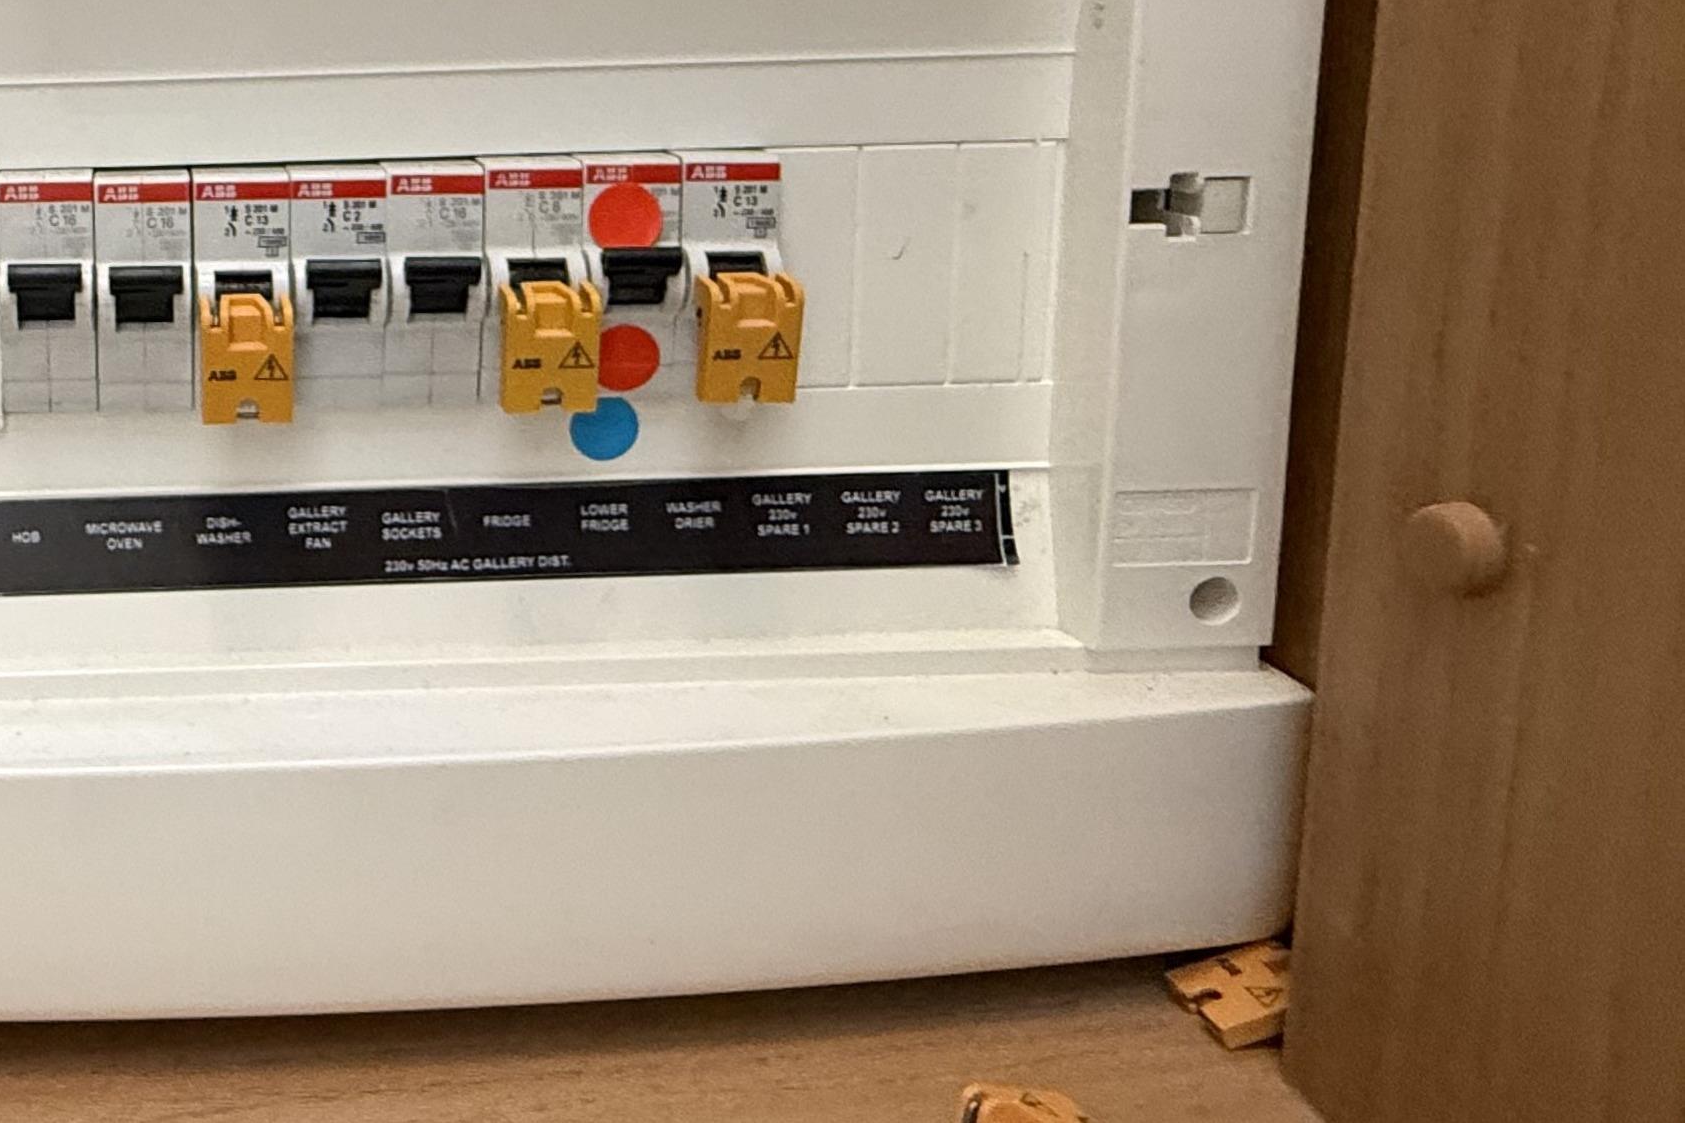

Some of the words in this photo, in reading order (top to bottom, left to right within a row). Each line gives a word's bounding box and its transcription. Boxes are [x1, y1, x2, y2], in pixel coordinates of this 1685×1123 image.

[690, 165, 727, 179] ABB
[495, 173, 530, 187] ABB
[4, 186, 39, 200] ABB
[103, 187, 138, 201] ABB
[202, 185, 236, 198] ABB
[714, 349, 741, 360] ABB
[512, 359, 541, 369] ABB
[208, 370, 237, 381] ABB
[752, 493, 812, 506] GALLERY
[841, 491, 900, 503] GALLERY
[925, 489, 984, 501] GALLERY
[288, 506, 346, 519] GALLERY
[581, 504, 628, 516] LOWER
[666, 501, 722, 513] WASHER
[382, 512, 440, 524] GALLERY
[483, 515, 530, 527] FRIDGE
[675, 517, 714, 529] DRIER
[85, 521, 162, 534] MICROWAVE
[288, 521, 348, 535] EXTRACT
[581, 519, 629, 531] FRIDGE
[758, 525, 799, 537] SPARE
[804, 524, 810, 535] 1
[847, 523, 888, 534] SPARE
[930, 521, 971, 532] SPARE
[12, 531, 41, 543] HOB
[196, 532, 252, 545] WASHER
[382, 527, 442, 540] SOCKETS
[106, 538, 143, 550] OVEN
[305, 538, 332, 549] FAN
[385, 561, 413, 572] 230v
[417, 560, 448, 571] 50Hz
[451, 559, 470, 571] AC
[473, 557, 535, 570] GALLERY
